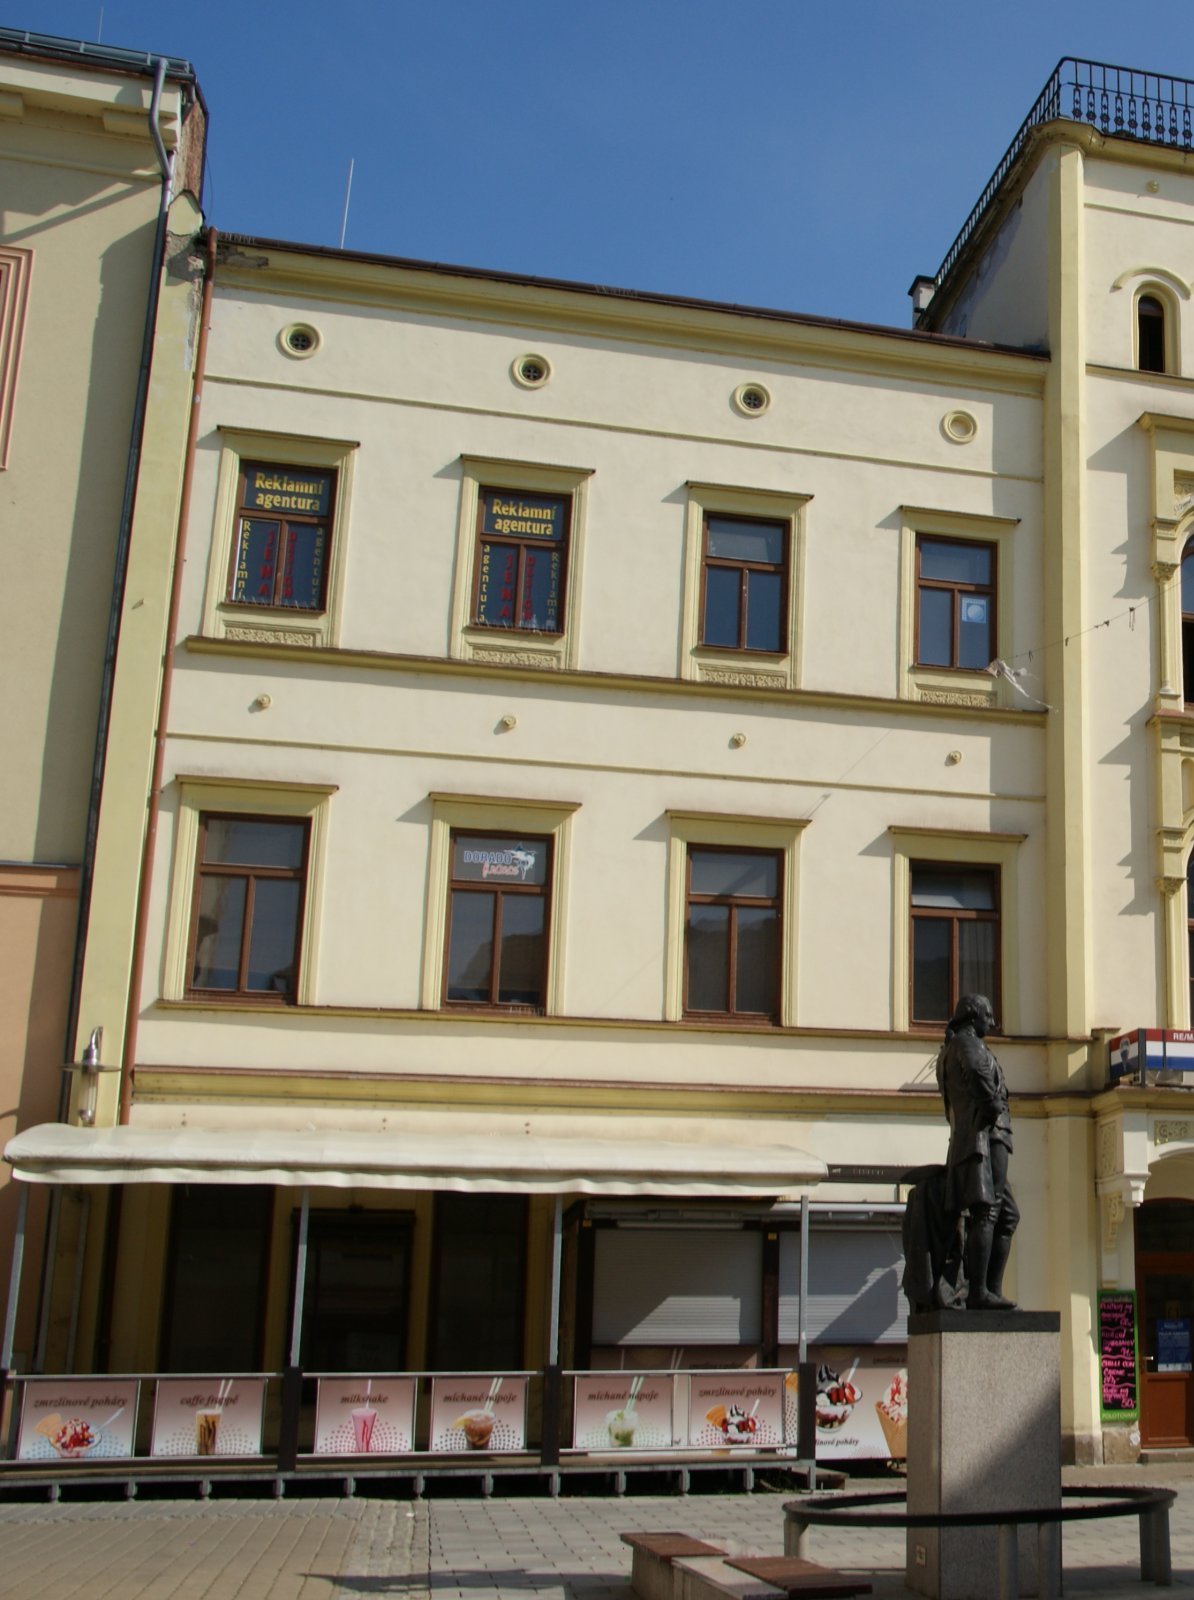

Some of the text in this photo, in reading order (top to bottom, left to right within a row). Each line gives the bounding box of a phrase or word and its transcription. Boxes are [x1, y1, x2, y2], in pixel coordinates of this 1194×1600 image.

[255, 472, 325, 494] Reklamní
[256, 492, 320, 511] agentura
[492, 498, 557, 520] Reklamní
[494, 518, 554, 536] agentura
[237, 520, 251, 600] Reklamní
[479, 544, 491, 623] agentura
[463, 850, 513, 865] DORADO
[698, 1385, 777, 1398] zmrzlinové poháry
[34, 1395, 129, 1409] zmrzlinové poháry
[835, 1437, 860, 1447] poháry
